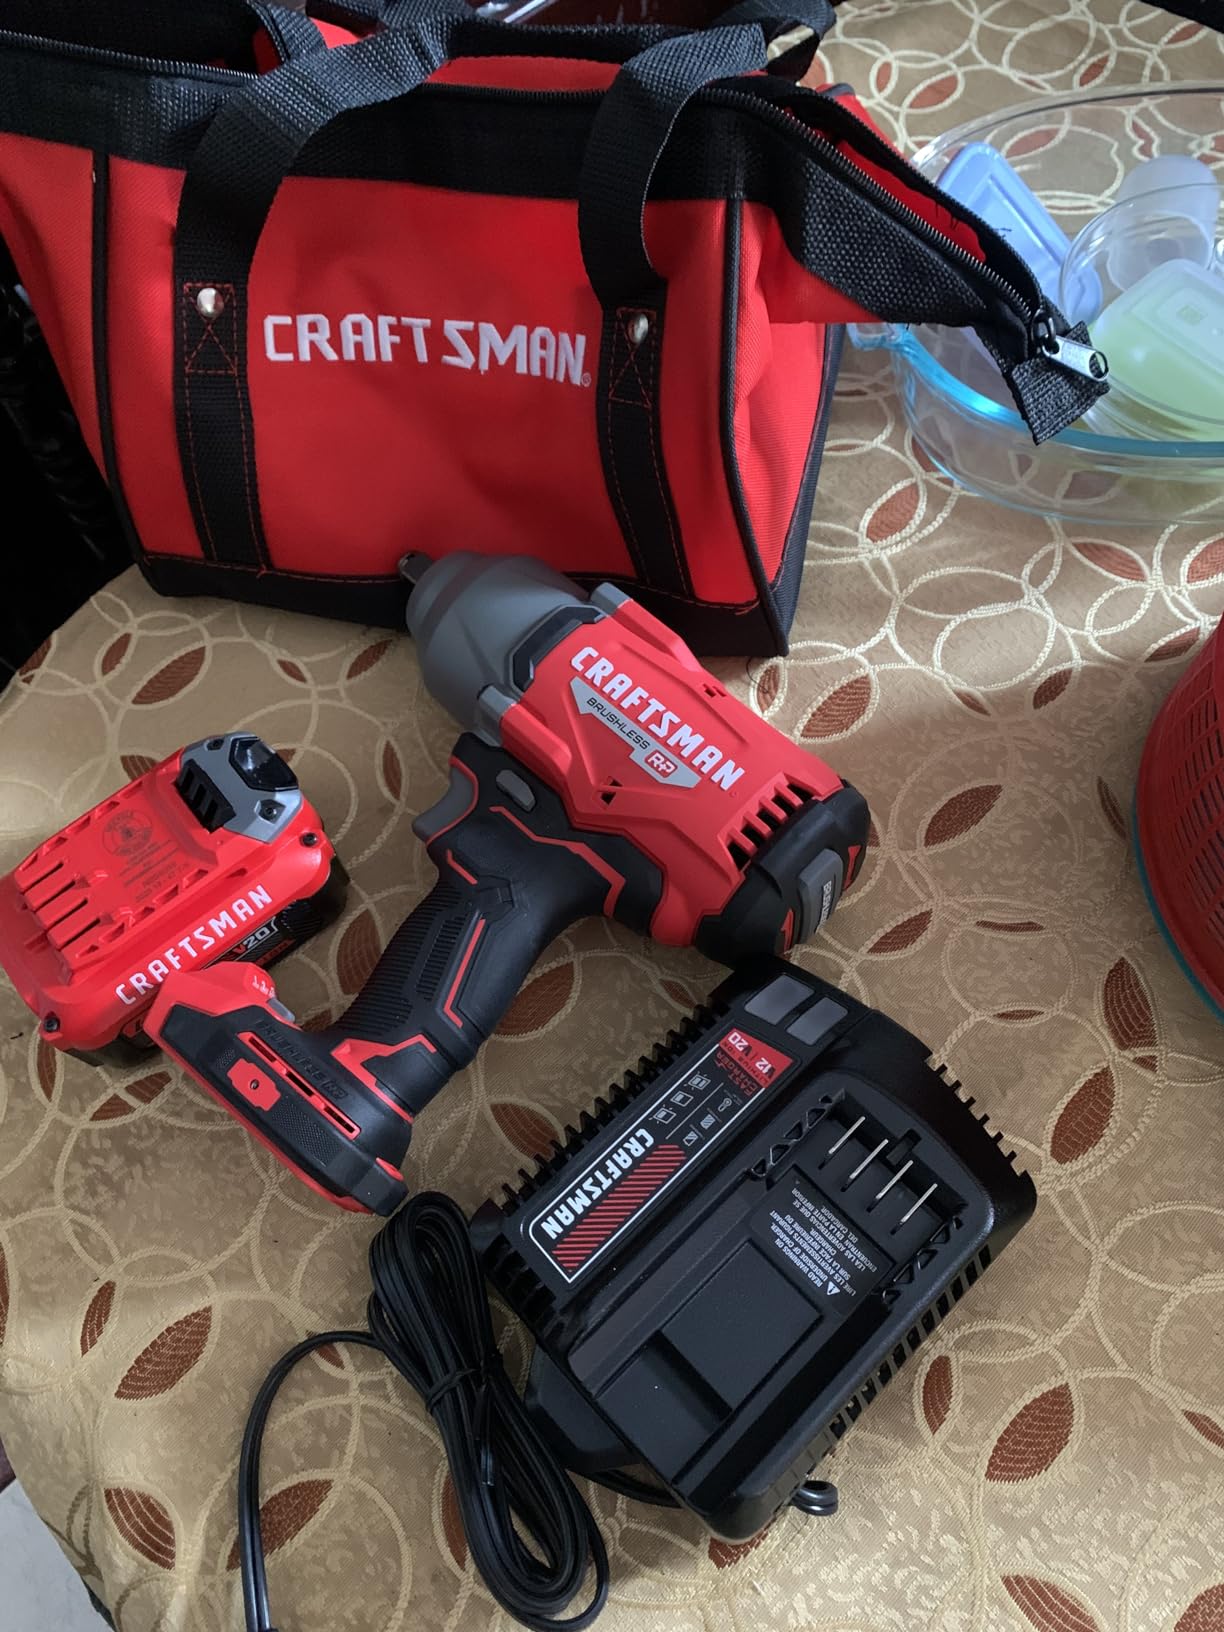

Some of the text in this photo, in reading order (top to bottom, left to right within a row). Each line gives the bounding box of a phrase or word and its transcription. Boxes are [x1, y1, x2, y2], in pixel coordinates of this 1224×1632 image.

[264, 313, 586, 386] CRAFTSMAN
[571, 647, 745, 791] CRAFTSMAN
[586, 697, 651, 750] BRUSHLESS
[115, 885, 272, 1005] CRAFTSMAN
[232, 925, 271, 956] V20
[541, 1129, 654, 1239] CRAFTSMAN
[792, 1198, 802, 1208] SE
[769, 1209, 795, 1234] FIGURANT
[784, 1213, 794, 1224] DU
[812, 1208, 830, 1226] PARTE
[808, 1215, 846, 1252] ADVERTENCIAS
[827, 1223, 837, 1233] LA
[834, 1230, 844, 1240] EN
[846, 1231, 858, 1243] DEL
[791, 1232, 836, 1275] AVERTISSEMENTS
[792, 1245, 801, 1254] OF
[818, 1247, 833, 1263] FACE
[843, 1249, 856, 1262] LAS
[774, 1237, 823, 1287] READ WARNINGS ON
[798, 1252, 828, 1281] UNDERSIDE
[830, 1260, 840, 1270] LA
[853, 1259, 866, 1271] LEA
[832, 1272, 845, 1285] LES
[837, 1267, 851, 1280] SUR
